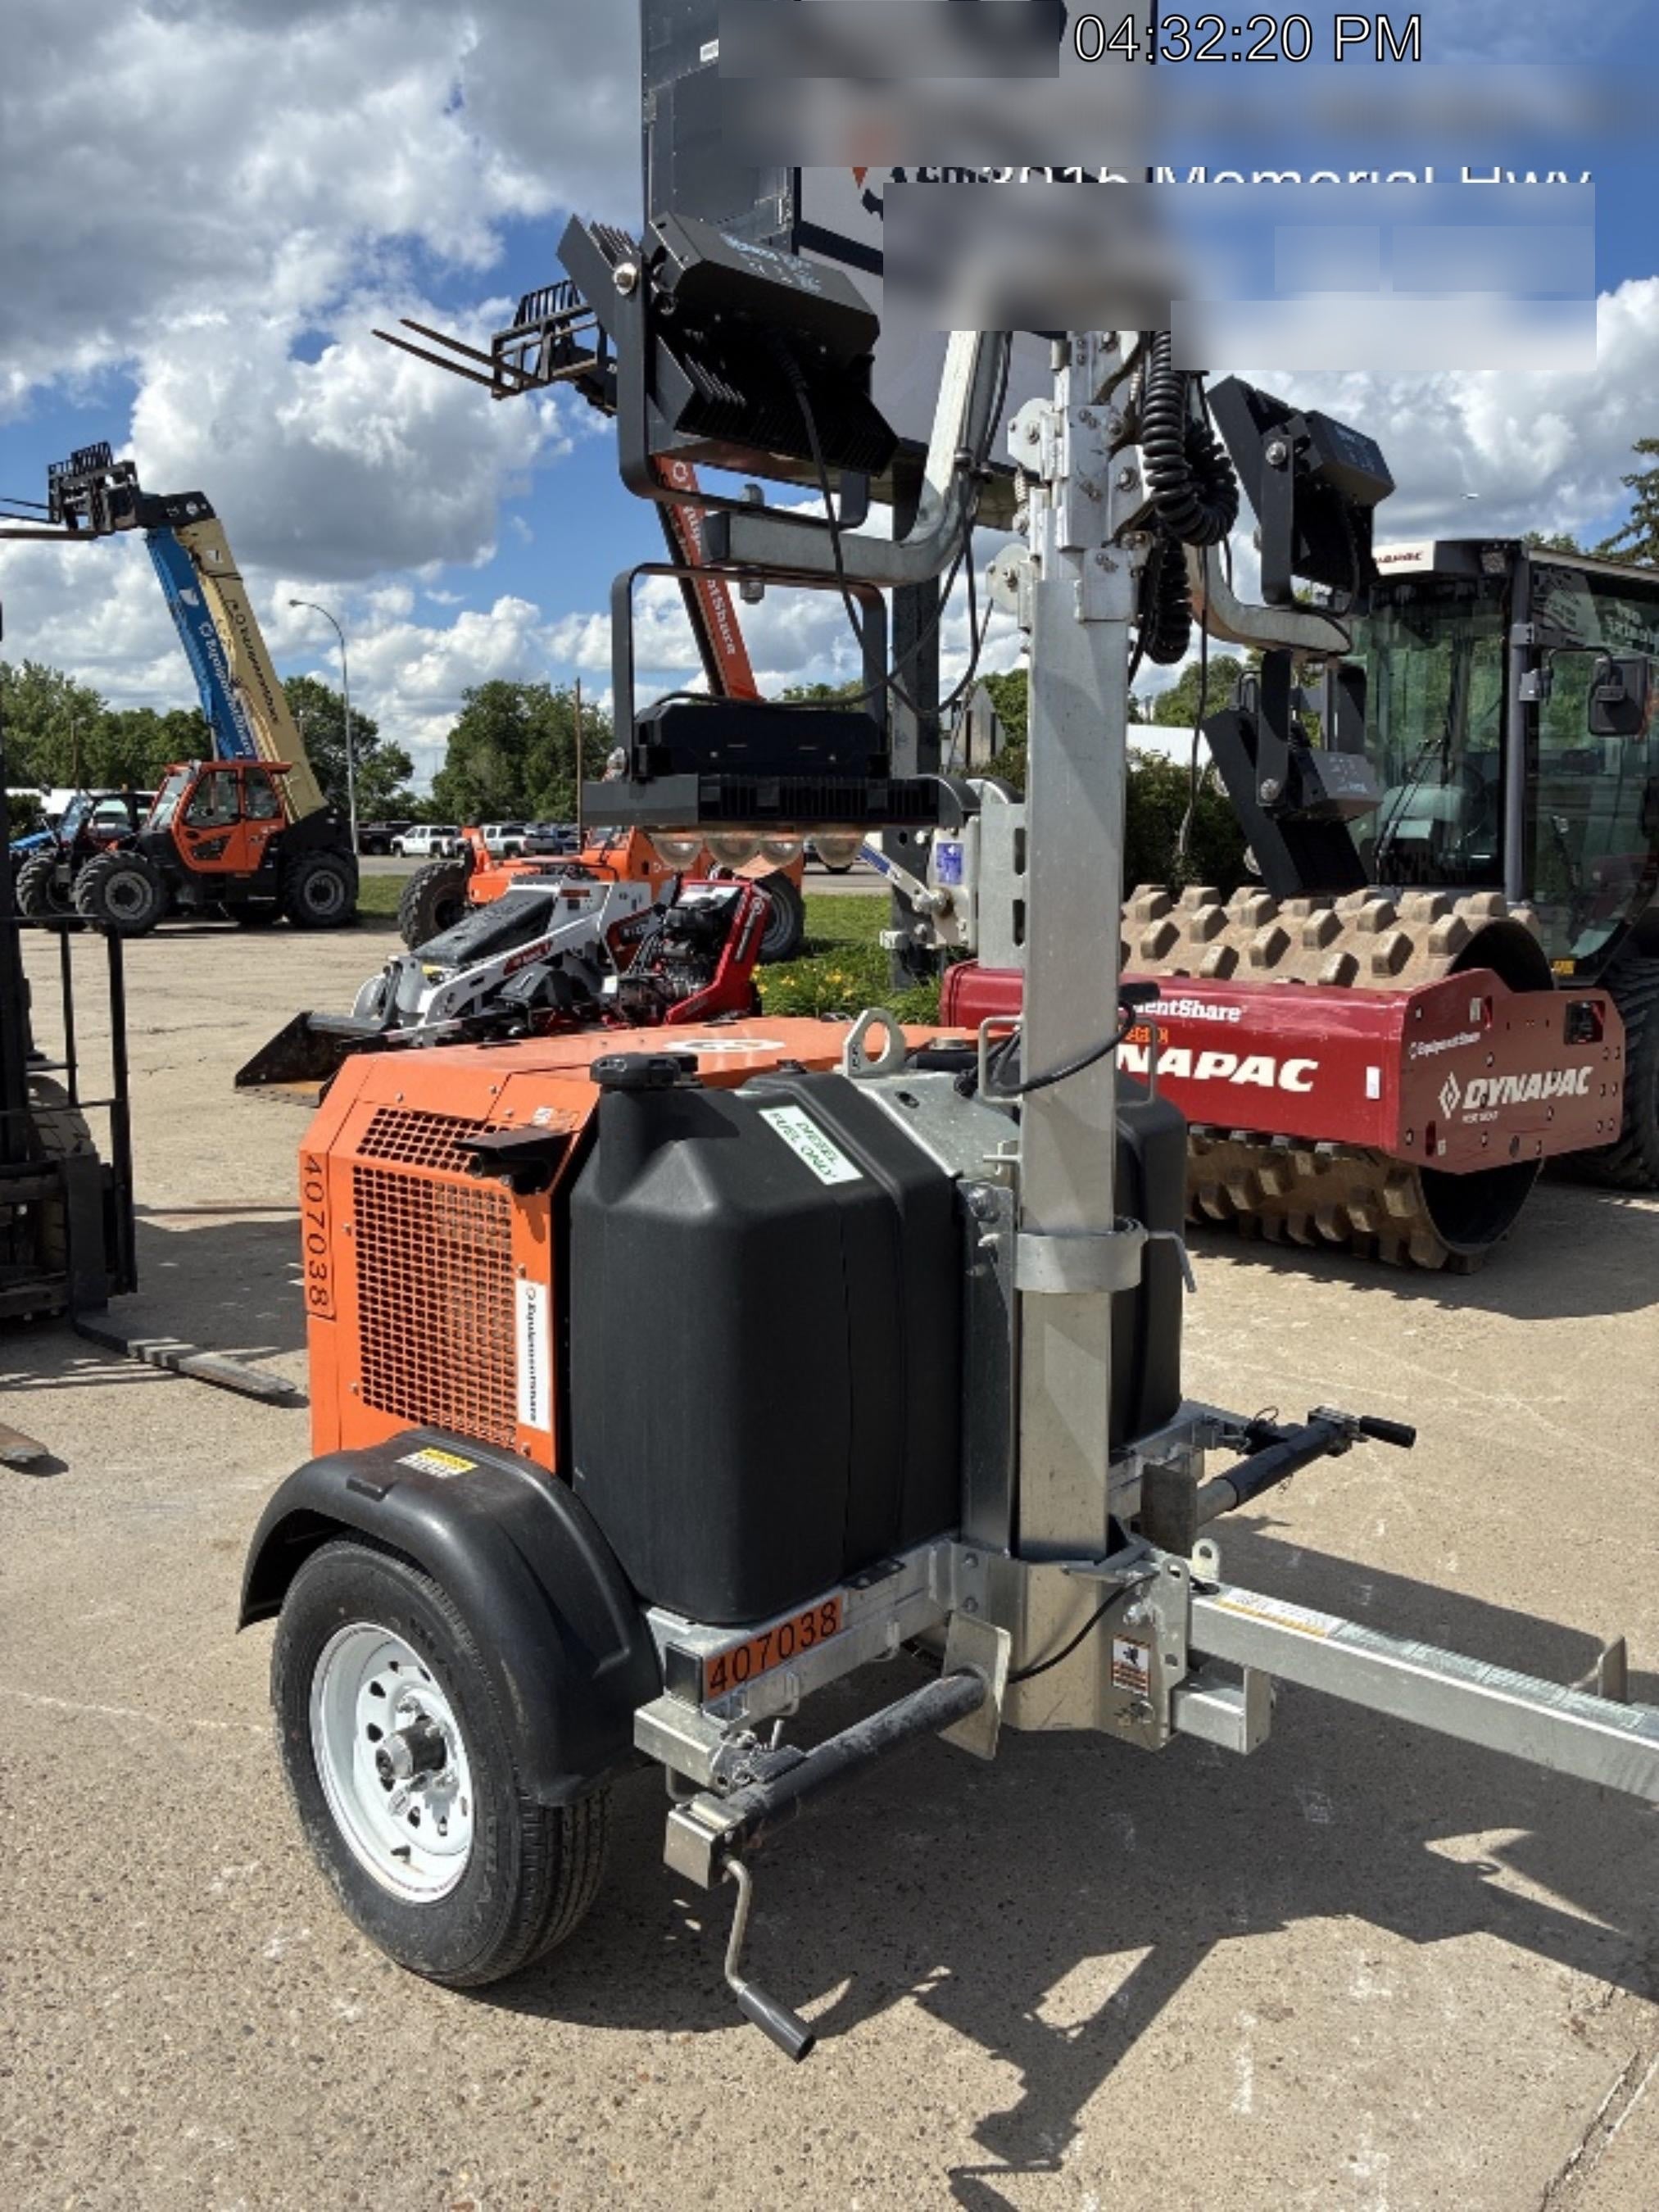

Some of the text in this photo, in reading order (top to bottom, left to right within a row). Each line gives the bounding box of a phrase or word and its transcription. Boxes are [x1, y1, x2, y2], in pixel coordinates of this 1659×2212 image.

[1117, 1043, 1318, 1092] NAPAC
[1462, 1066, 1593, 1109] DYNAPAC
[304, 1154, 328, 1306] 407038
[709, 1602, 837, 1691] 407038
